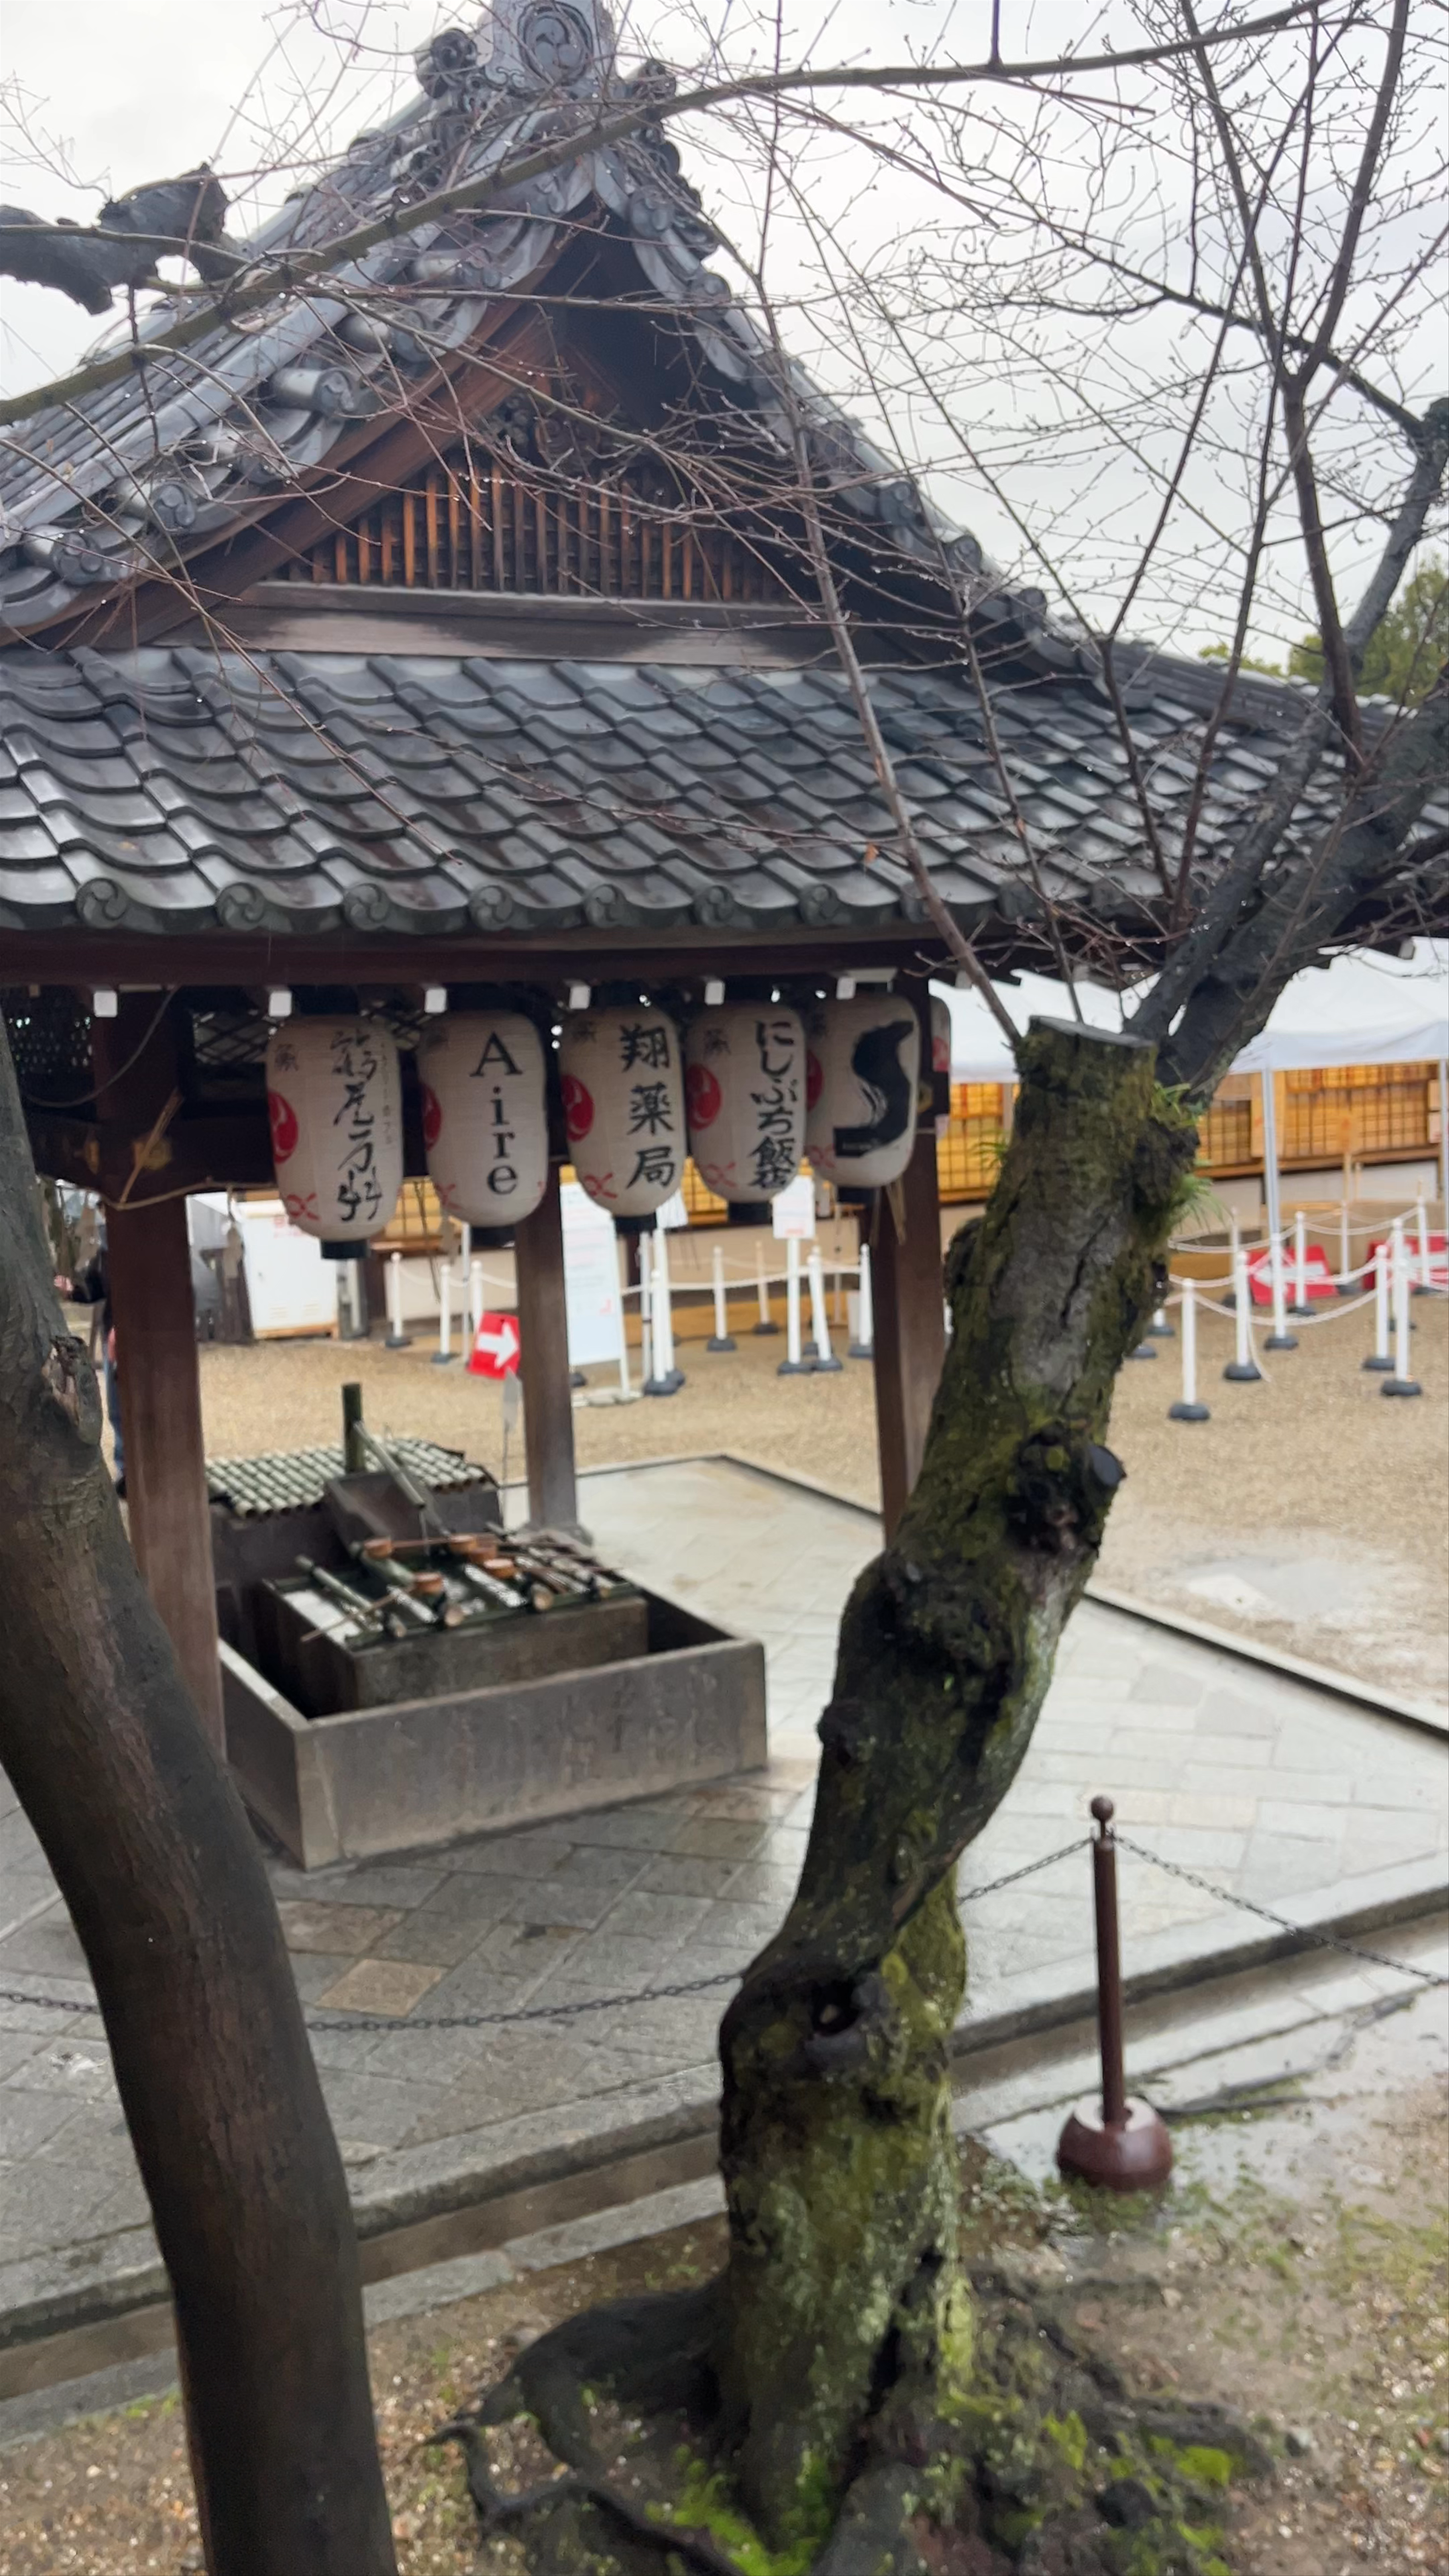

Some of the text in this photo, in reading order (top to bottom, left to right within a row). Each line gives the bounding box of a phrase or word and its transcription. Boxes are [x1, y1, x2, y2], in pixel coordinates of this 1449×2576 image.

[469, 1031, 523, 1195] Aire
[619, 1023, 675, 1190] 翔薬局
[748, 1020, 799, 1189] にしぶち飯店
